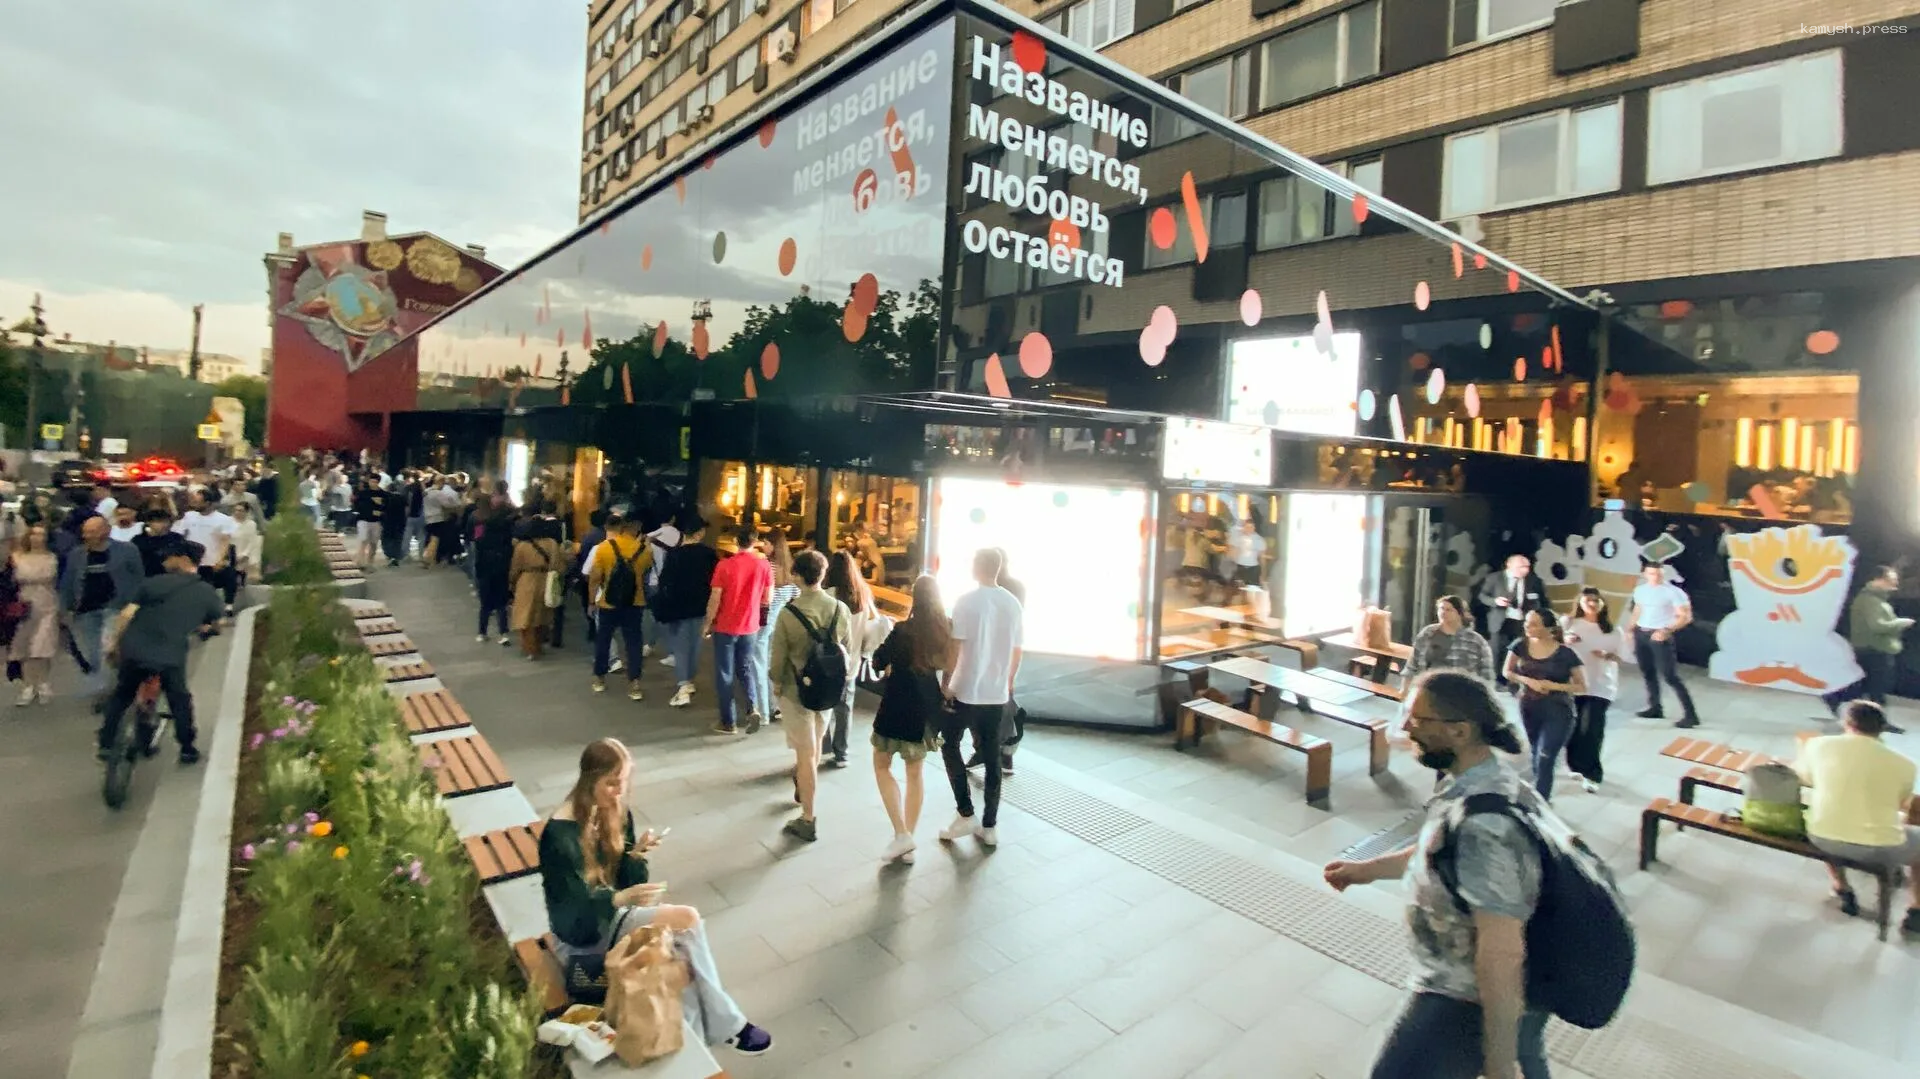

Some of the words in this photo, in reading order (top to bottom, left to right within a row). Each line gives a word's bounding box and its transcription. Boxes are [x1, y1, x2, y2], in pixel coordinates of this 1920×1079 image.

[796, 48, 938, 151] Название
[970, 35, 1148, 148] Название
[792, 108, 935, 197] меняется,
[965, 161, 1109, 234] любовь
[968, 104, 1149, 205] меняется,
[963, 219, 1124, 288] остаётся
